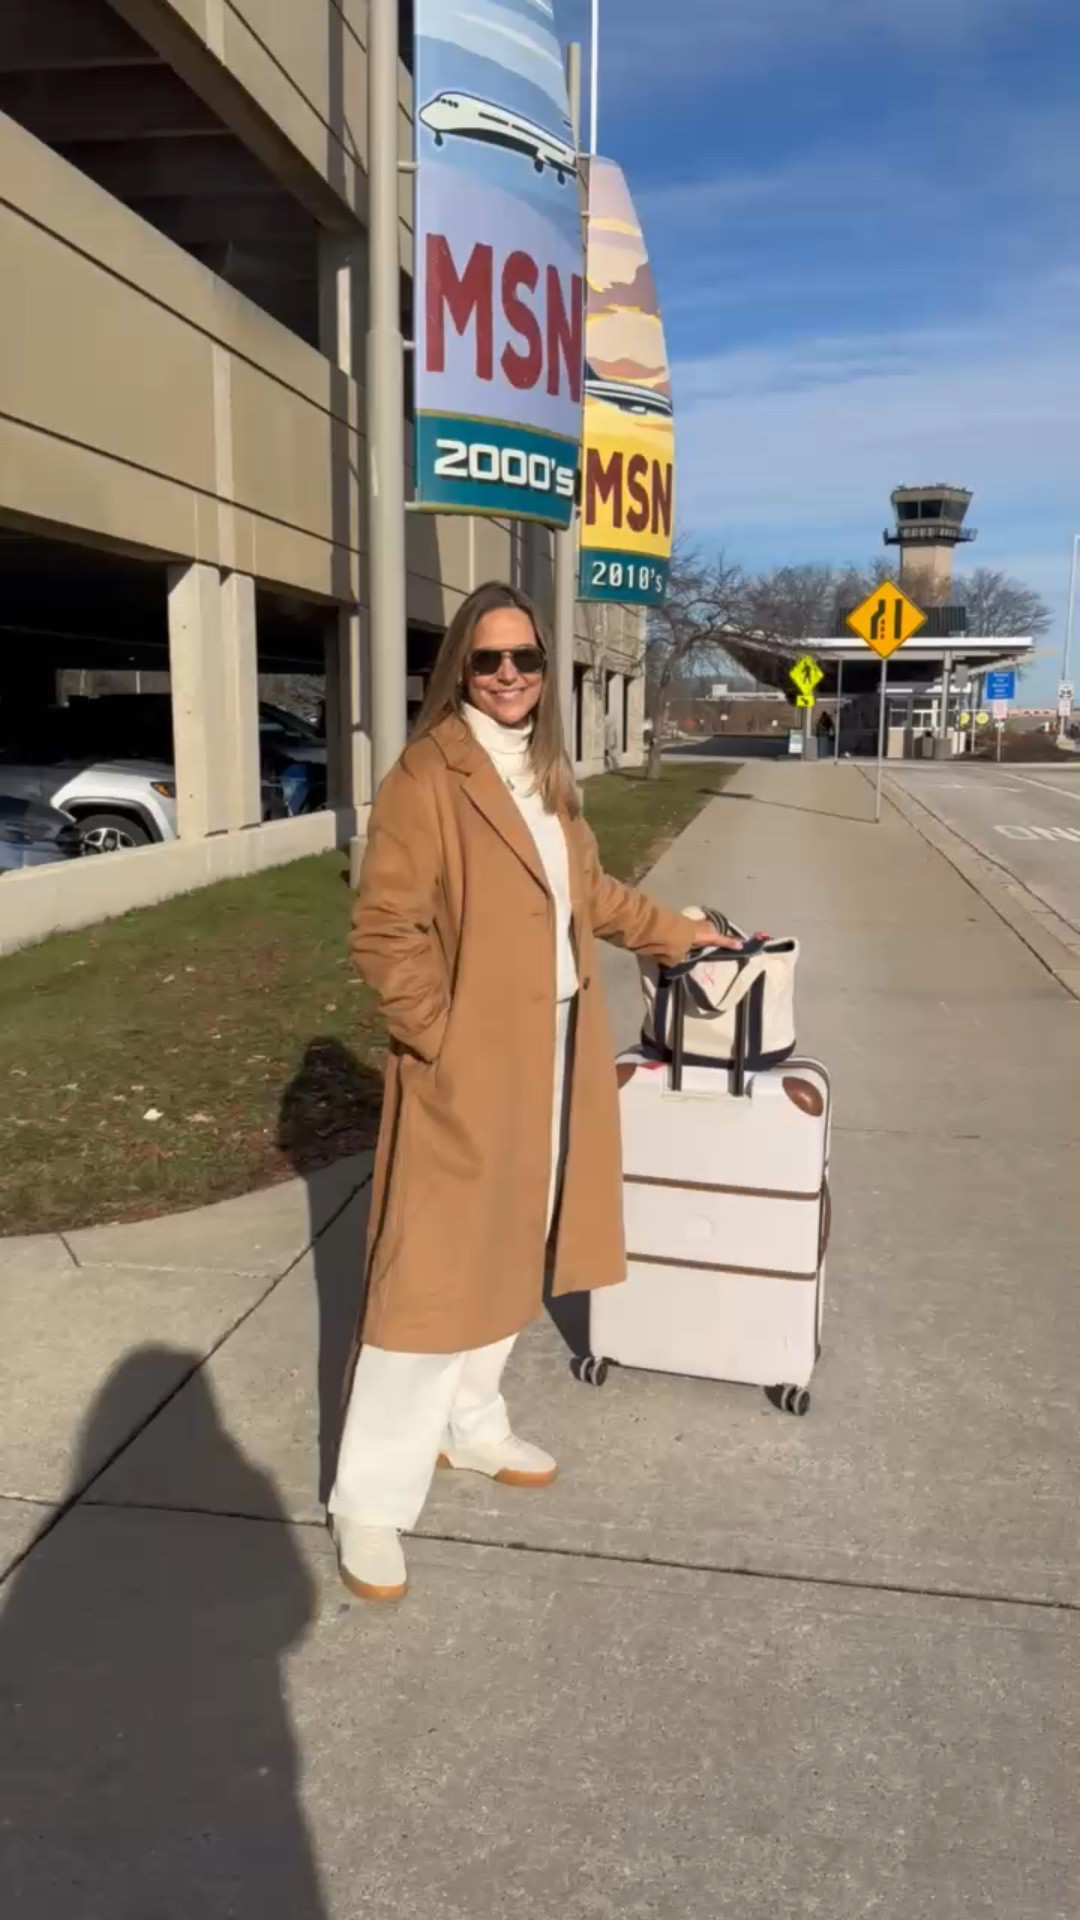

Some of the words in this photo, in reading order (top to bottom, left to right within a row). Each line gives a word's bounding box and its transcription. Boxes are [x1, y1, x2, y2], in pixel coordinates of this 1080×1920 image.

[426, 233, 582, 403] MSN
[434, 438, 574, 497] 2000's
[585, 447, 672, 537] MSN
[591, 561, 663, 593] 2010's
